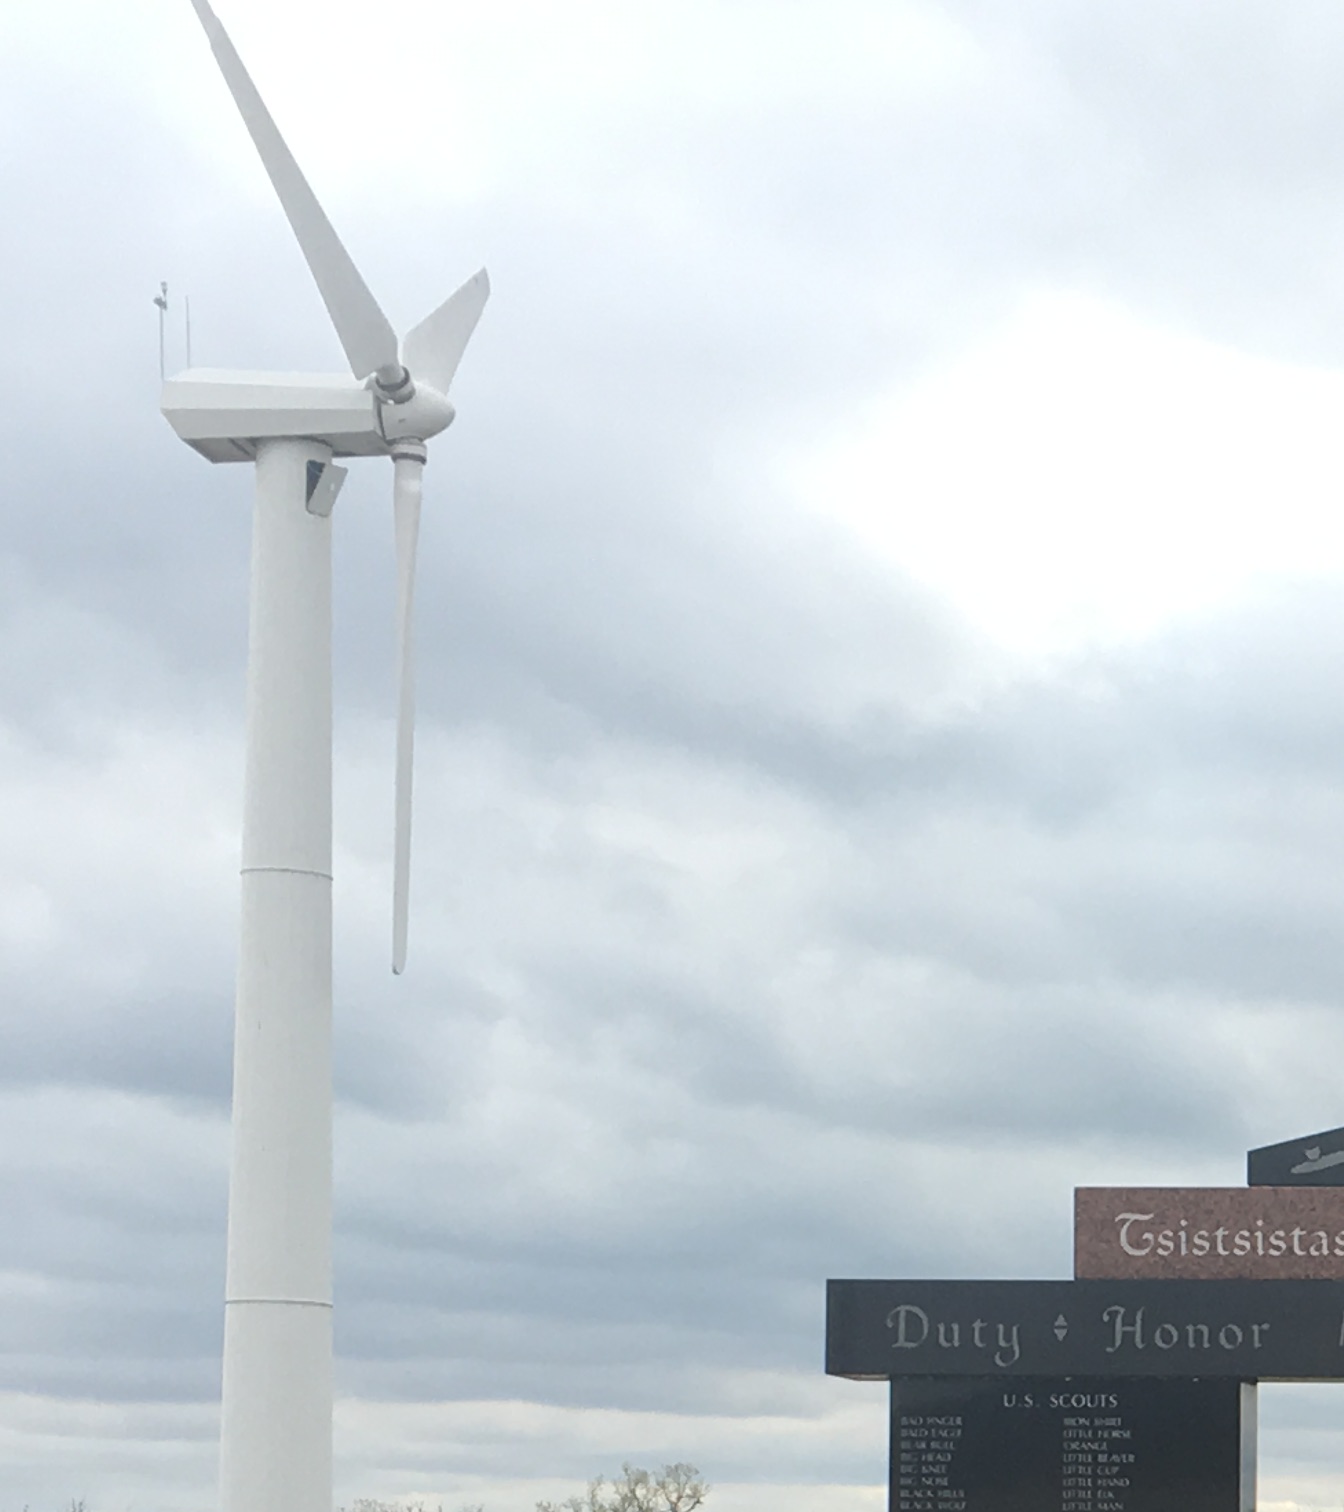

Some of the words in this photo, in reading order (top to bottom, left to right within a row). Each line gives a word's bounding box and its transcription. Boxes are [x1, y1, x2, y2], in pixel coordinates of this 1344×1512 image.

[886, 1304, 1021, 1367] Duty
[1102, 1304, 1271, 1352] Honor
[1003, 1394, 1041, 1408] U.S.
[1050, 1394, 1119, 1408] SCOUTS
